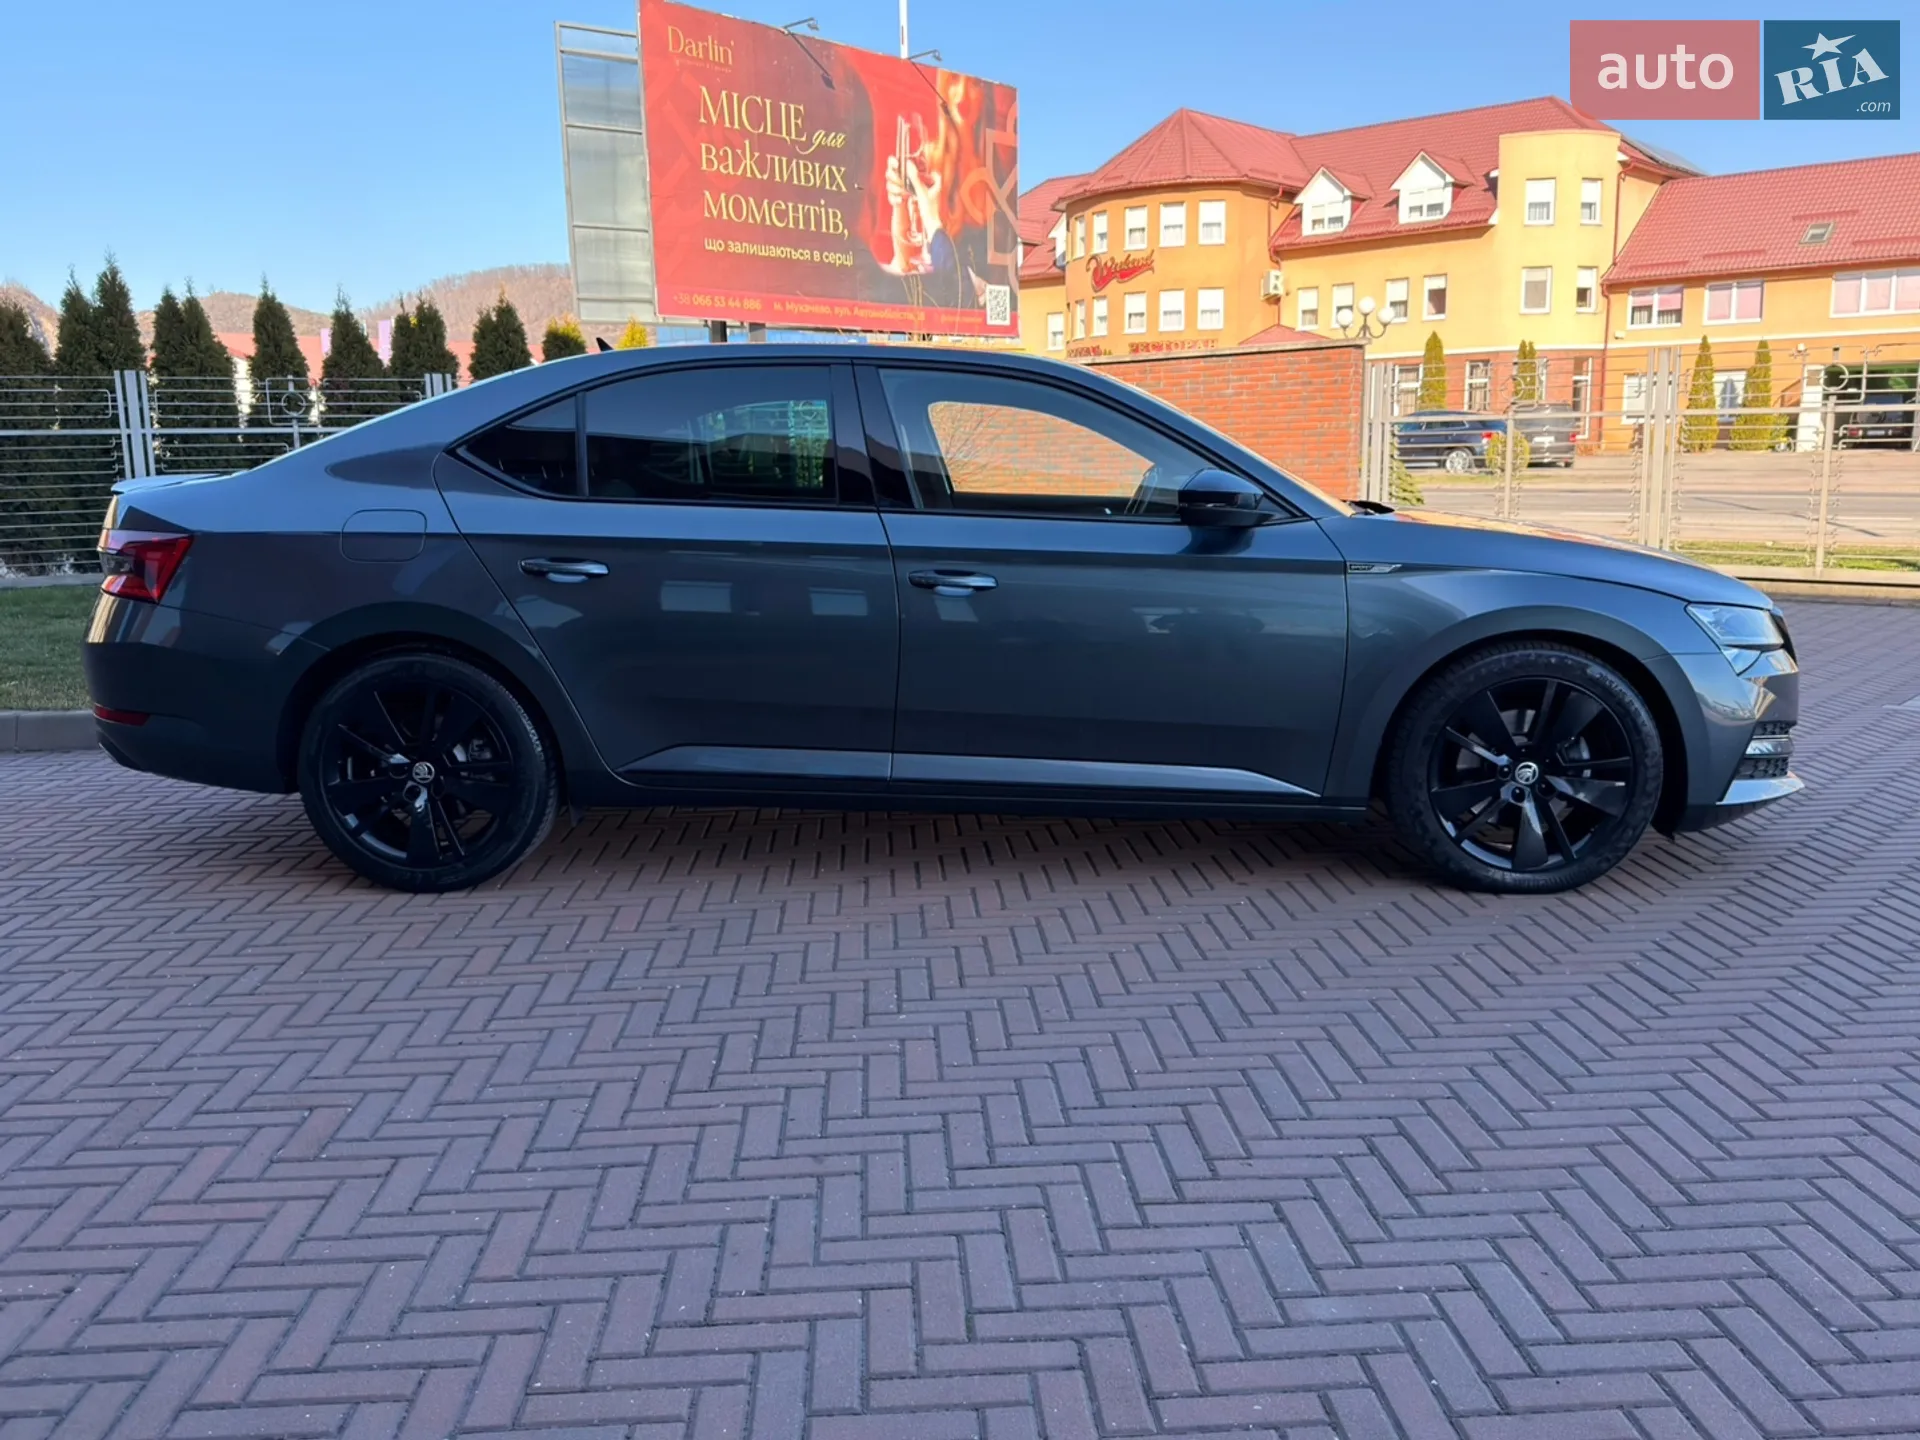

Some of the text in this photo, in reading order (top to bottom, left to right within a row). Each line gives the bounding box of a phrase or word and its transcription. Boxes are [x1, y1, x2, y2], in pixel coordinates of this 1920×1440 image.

[667, 25, 735, 66] Darlin'
[698, 85, 847, 155] МІСЦЕ для
[704, 236, 854, 267] що залишаються в серці
[692, 293, 712, 307] 066
